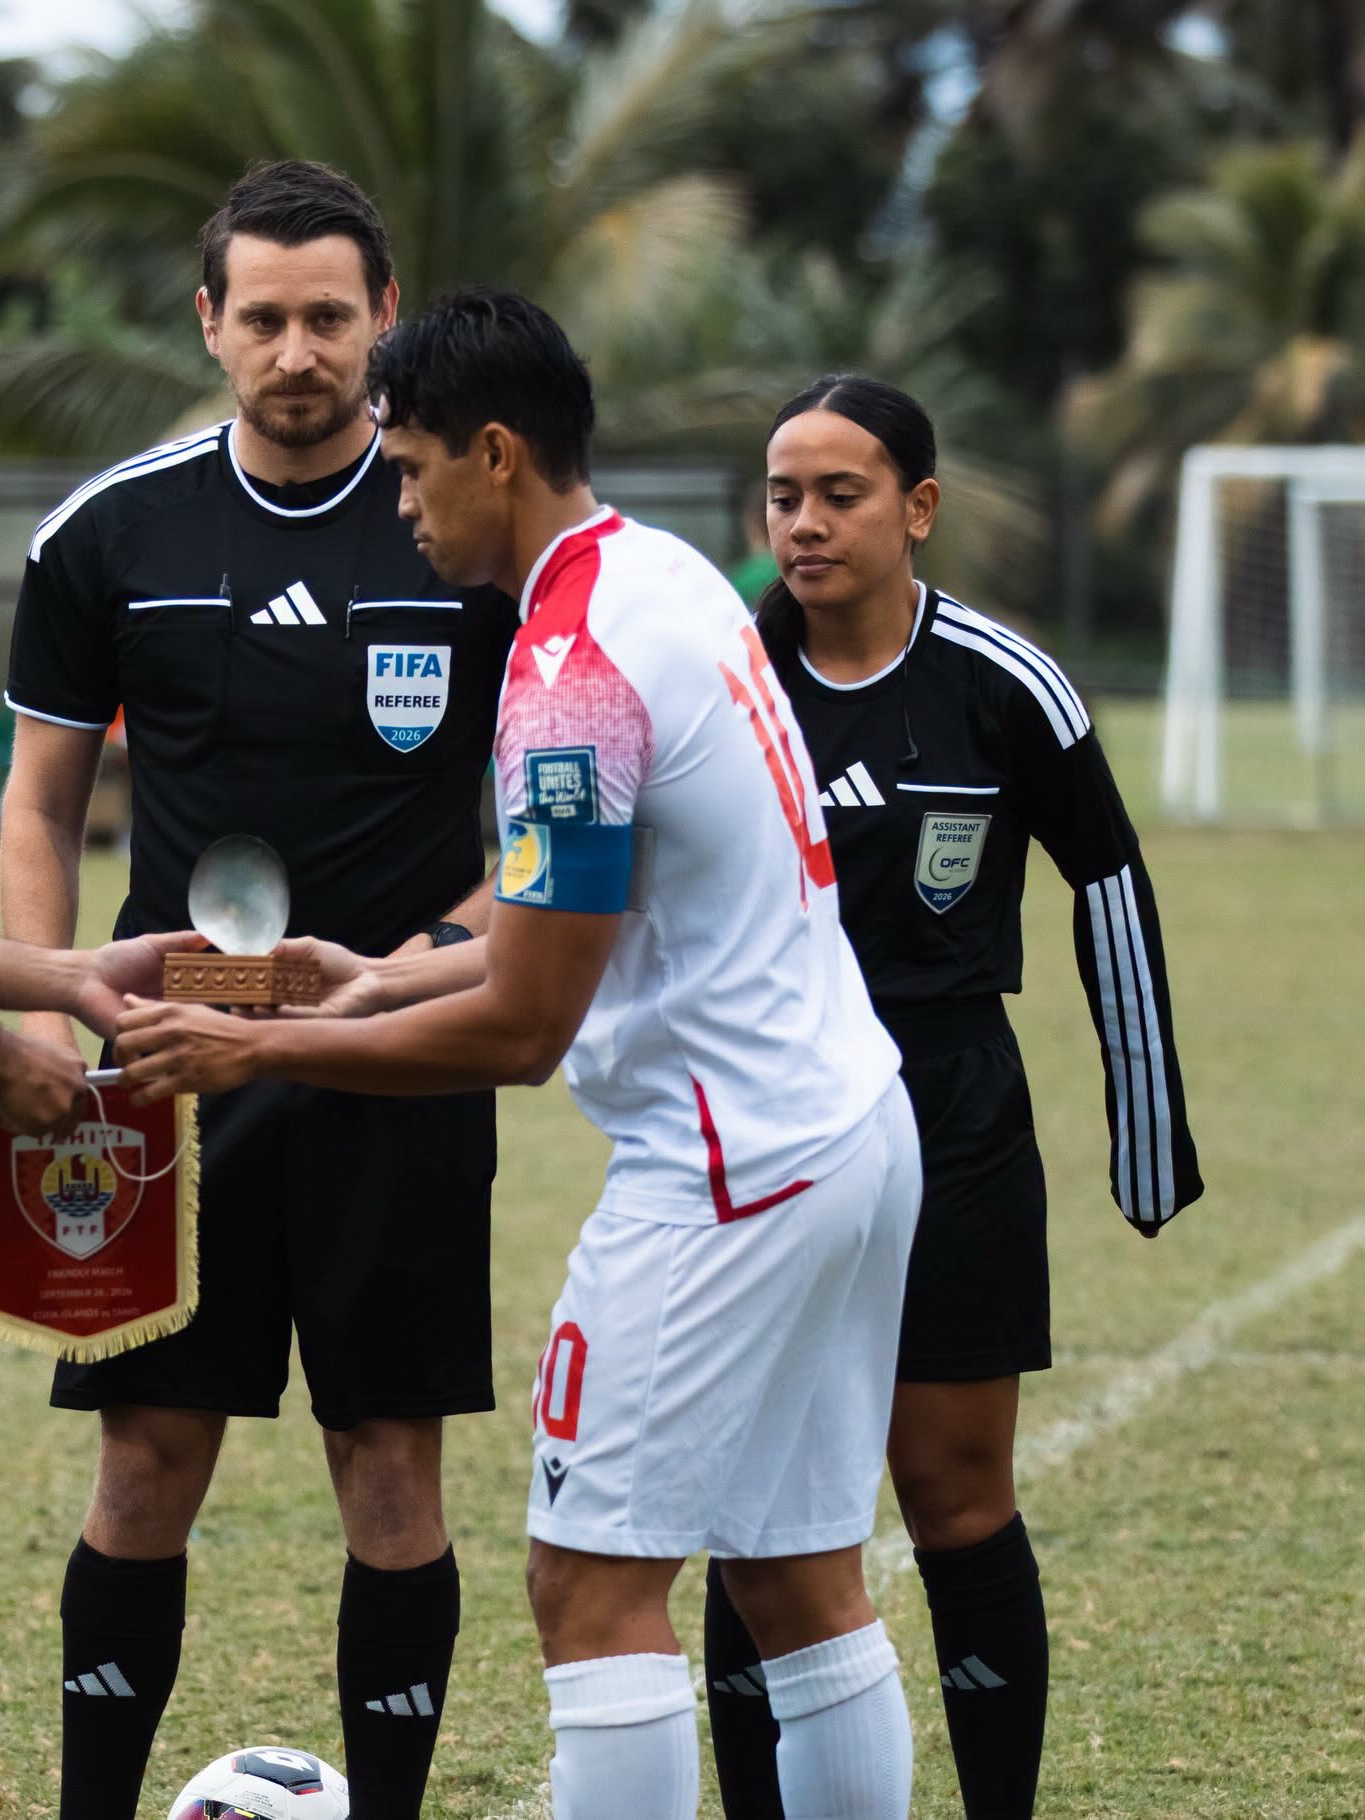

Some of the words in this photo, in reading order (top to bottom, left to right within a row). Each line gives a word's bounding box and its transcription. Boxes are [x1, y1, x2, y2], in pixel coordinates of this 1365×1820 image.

[375, 652, 443, 678] FIFA
[374, 694, 441, 709] REFEREE
[390, 729, 421, 741] 2026
[537, 761, 579, 774] FOOTBALL
[538, 773, 582, 791] UNITES
[931, 822, 980, 832] ASSISTANT
[936, 833, 973, 843] REFEREE
[940, 858, 971, 868] OFC
[932, 893, 952, 901] 2026
[533, 1320, 589, 1442] 0
